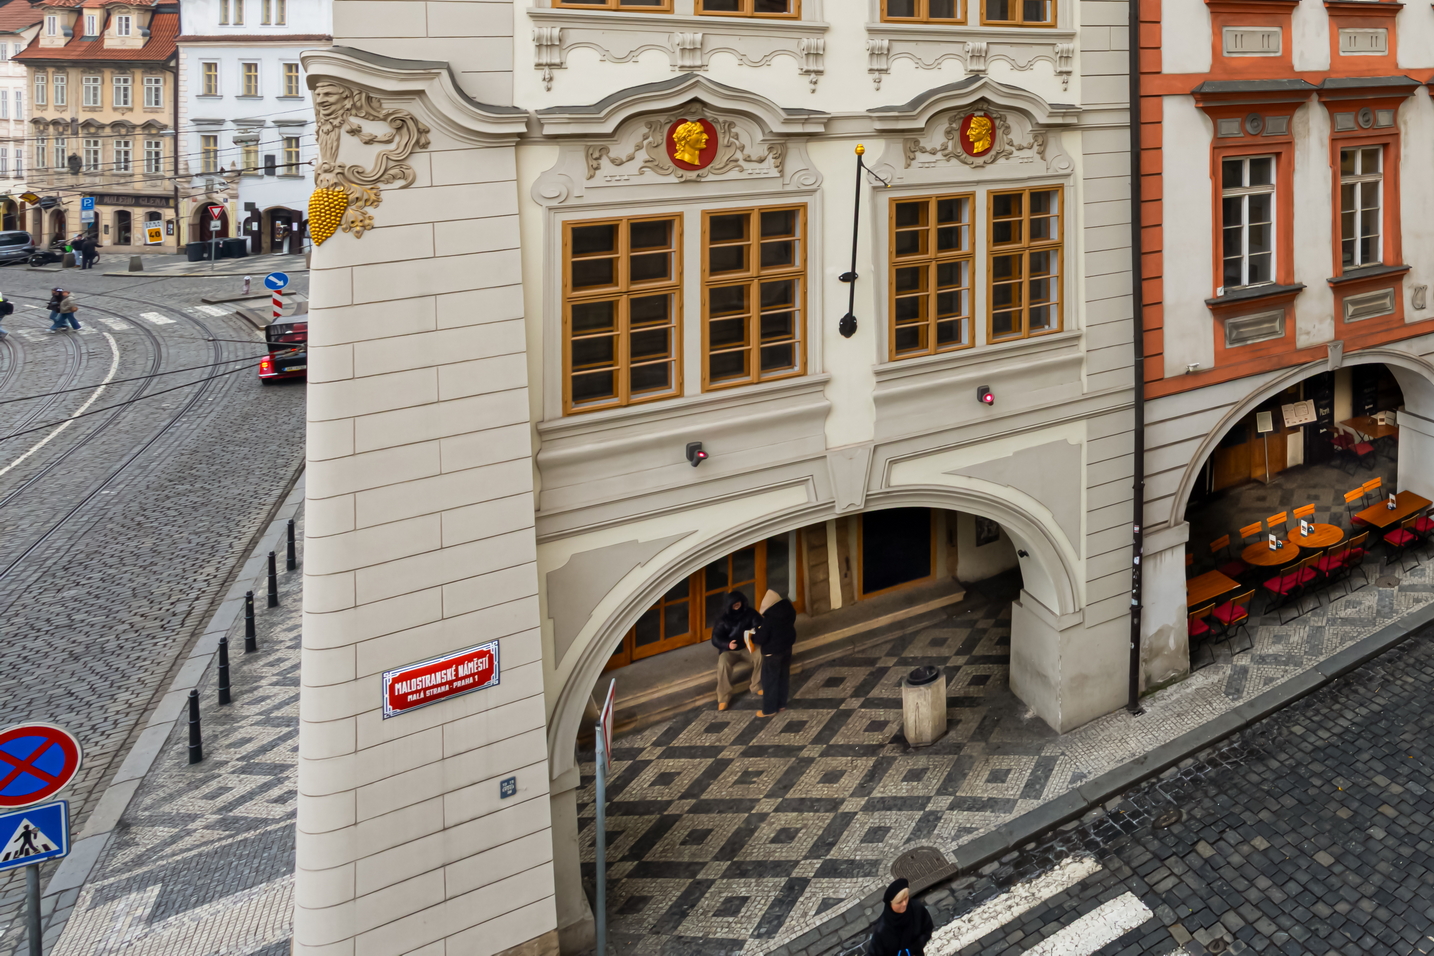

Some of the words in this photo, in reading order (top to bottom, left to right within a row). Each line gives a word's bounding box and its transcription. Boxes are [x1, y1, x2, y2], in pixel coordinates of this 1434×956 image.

[1411, 284, 1428, 310] U
[394, 664, 456, 696] MALOSTRANSKÉ
[458, 654, 489, 678] NÁMĚSTÍ
[407, 690, 425, 702] MALÁ
[425, 684, 449, 697] STRANA
[453, 677, 474, 689] PRAHA
